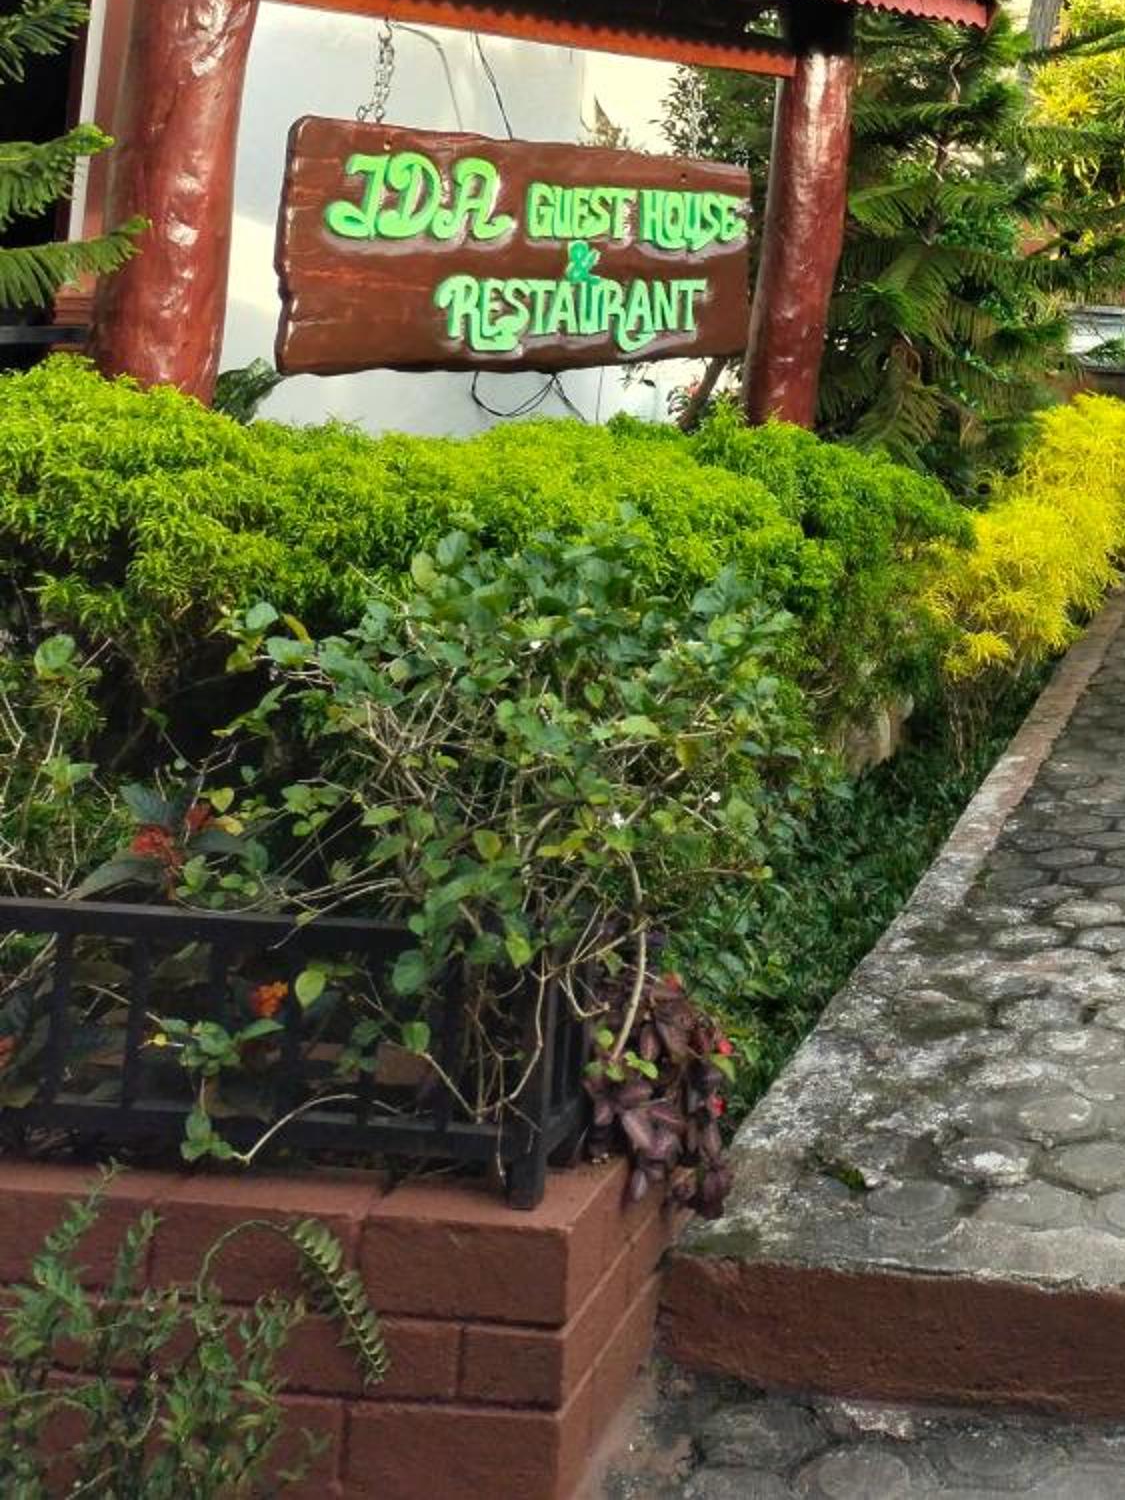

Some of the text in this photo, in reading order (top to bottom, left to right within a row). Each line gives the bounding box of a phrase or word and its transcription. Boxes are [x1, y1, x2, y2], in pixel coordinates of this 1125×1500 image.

[528, 182, 637, 239] GUEST
[640, 189, 748, 251] HOUSE
[566, 240, 601, 284] &
[434, 275, 707, 352] RESTAURANT
